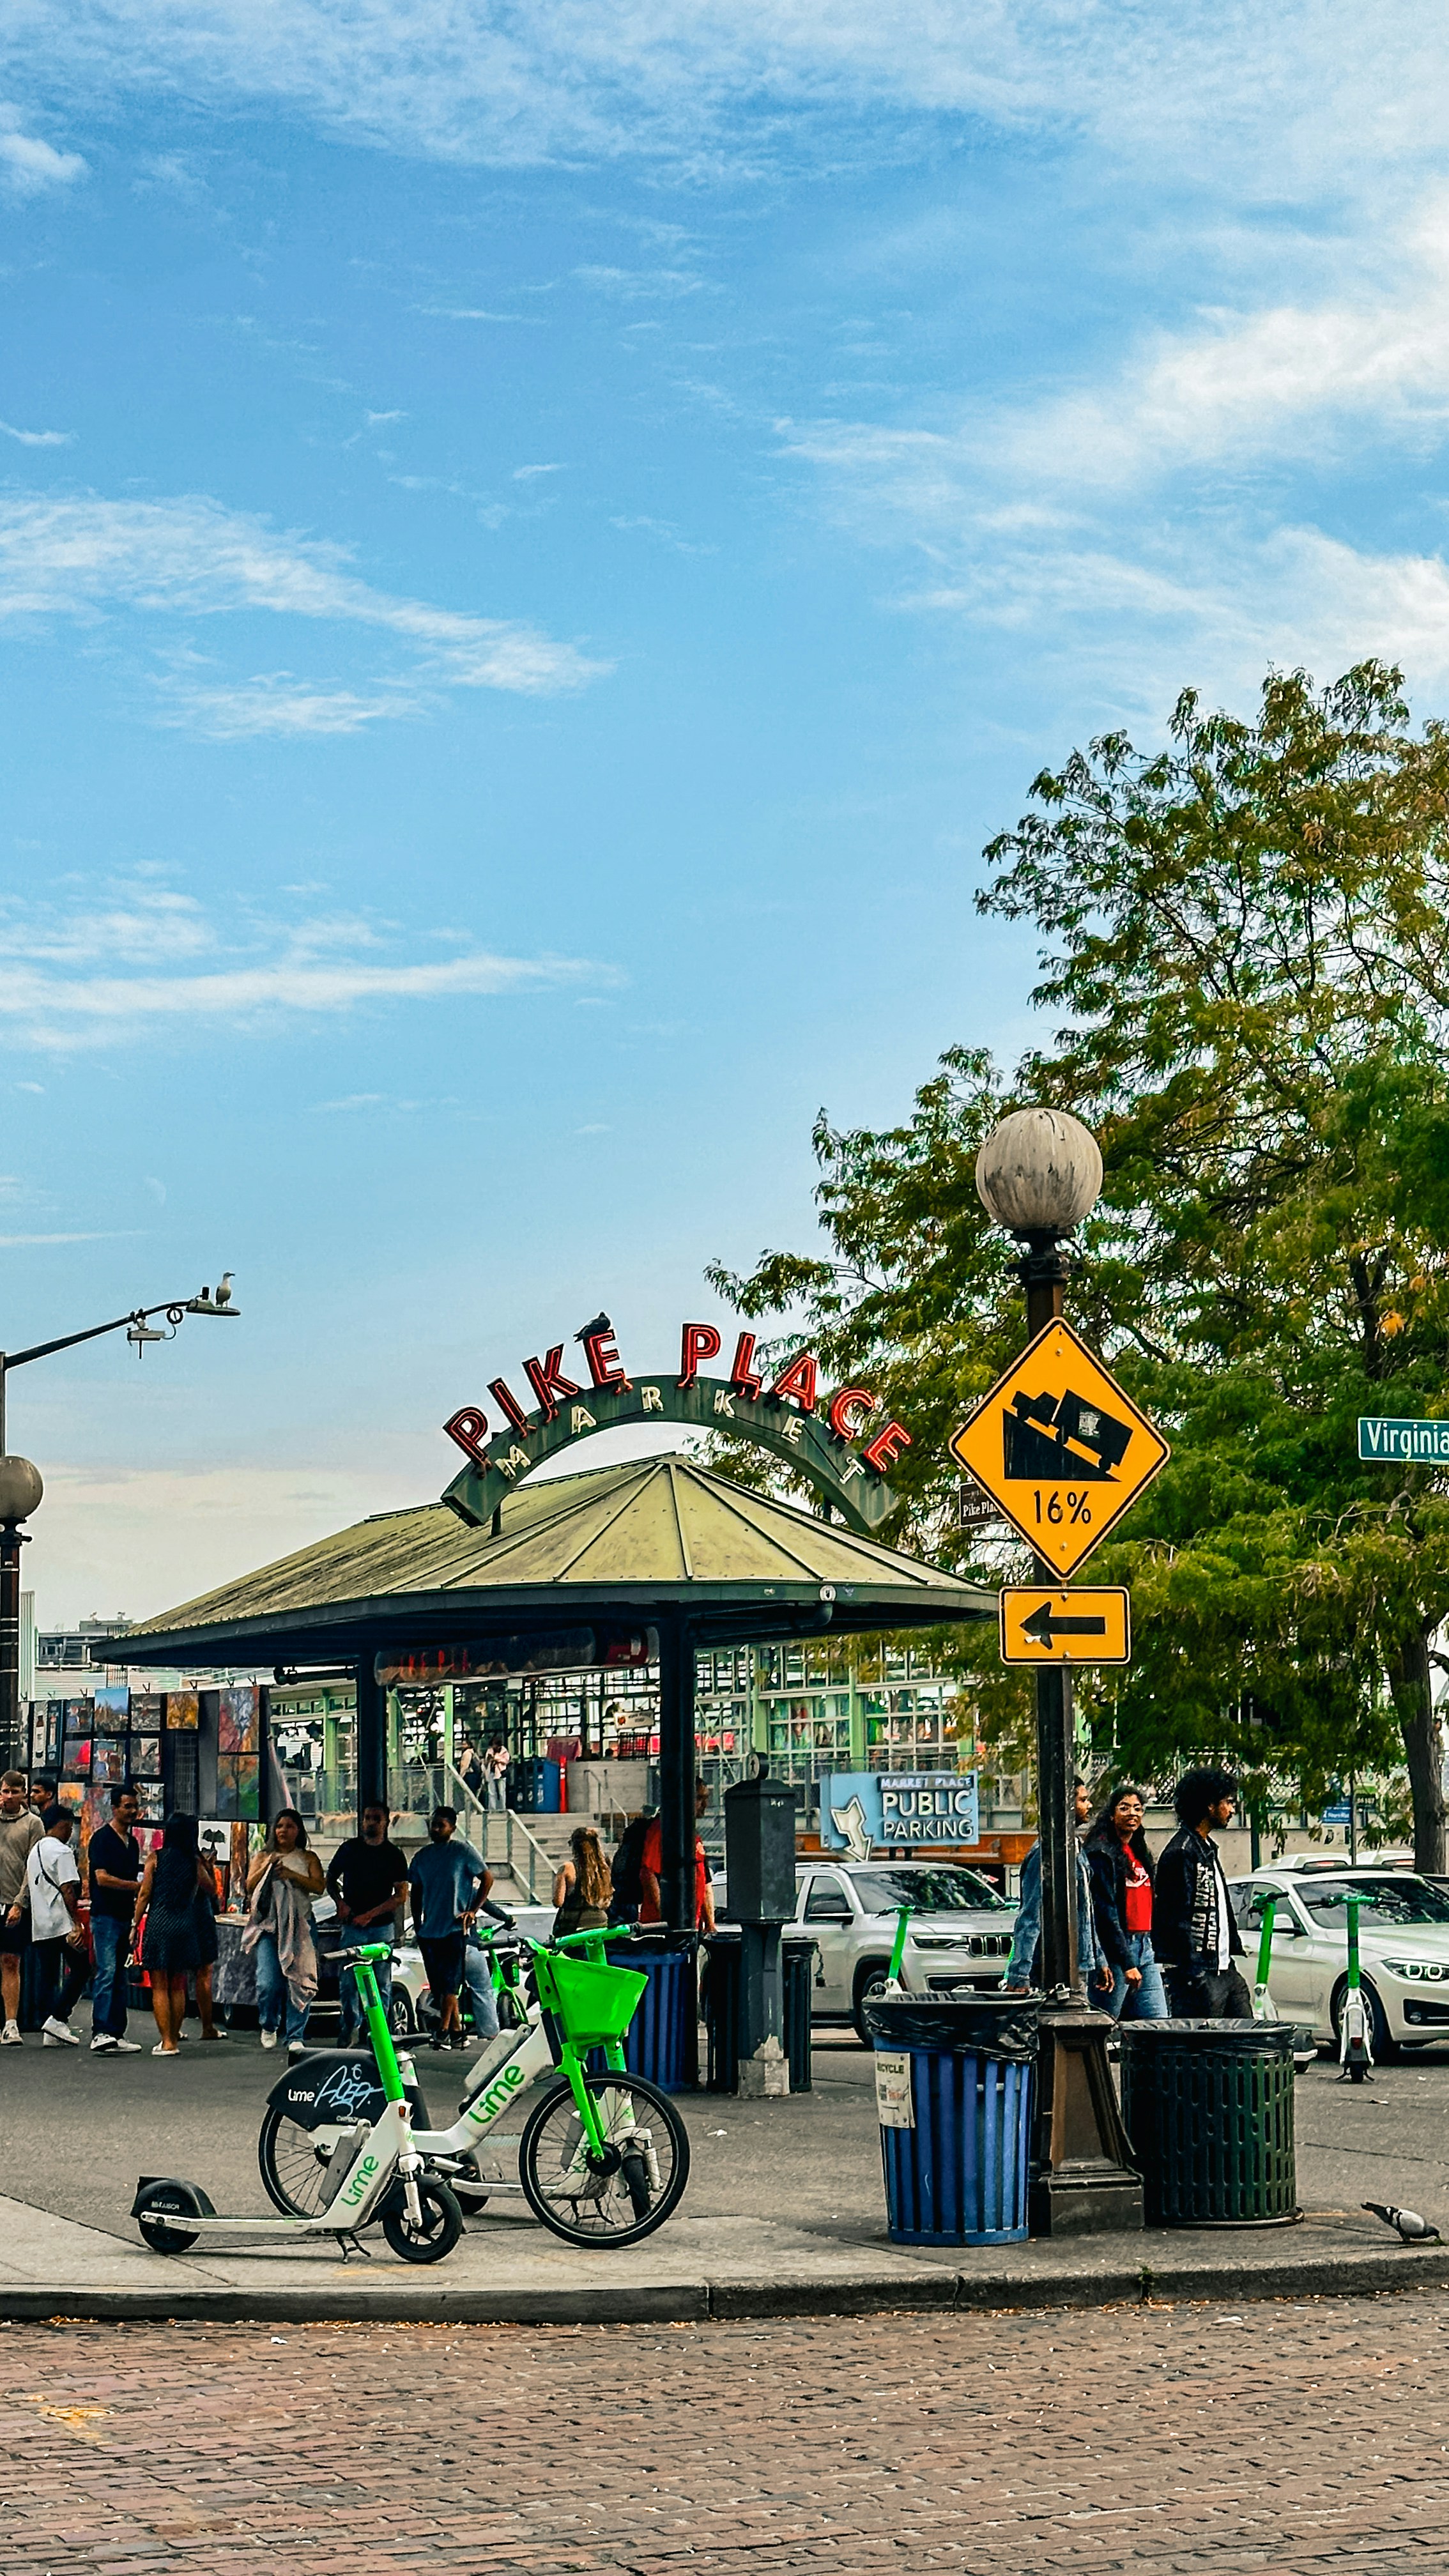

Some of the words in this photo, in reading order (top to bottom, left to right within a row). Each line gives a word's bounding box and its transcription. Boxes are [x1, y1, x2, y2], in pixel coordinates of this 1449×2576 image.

[442, 1329, 624, 1467] PIKE
[682, 1324, 912, 1471] PLACE
[495, 1386, 864, 1484] MARKET
[1367, 1422, 1449, 1459] Virginia
[963, 1503, 980, 1517] Pike
[1034, 1489, 1091, 1524] 16%
[882, 1790, 972, 1816] PUBLIC
[884, 1819, 973, 1839] PARKING
[288, 2089, 314, 2101] Lime
[468, 2066, 525, 2124] Lime
[341, 2156, 379, 2206] Lime
